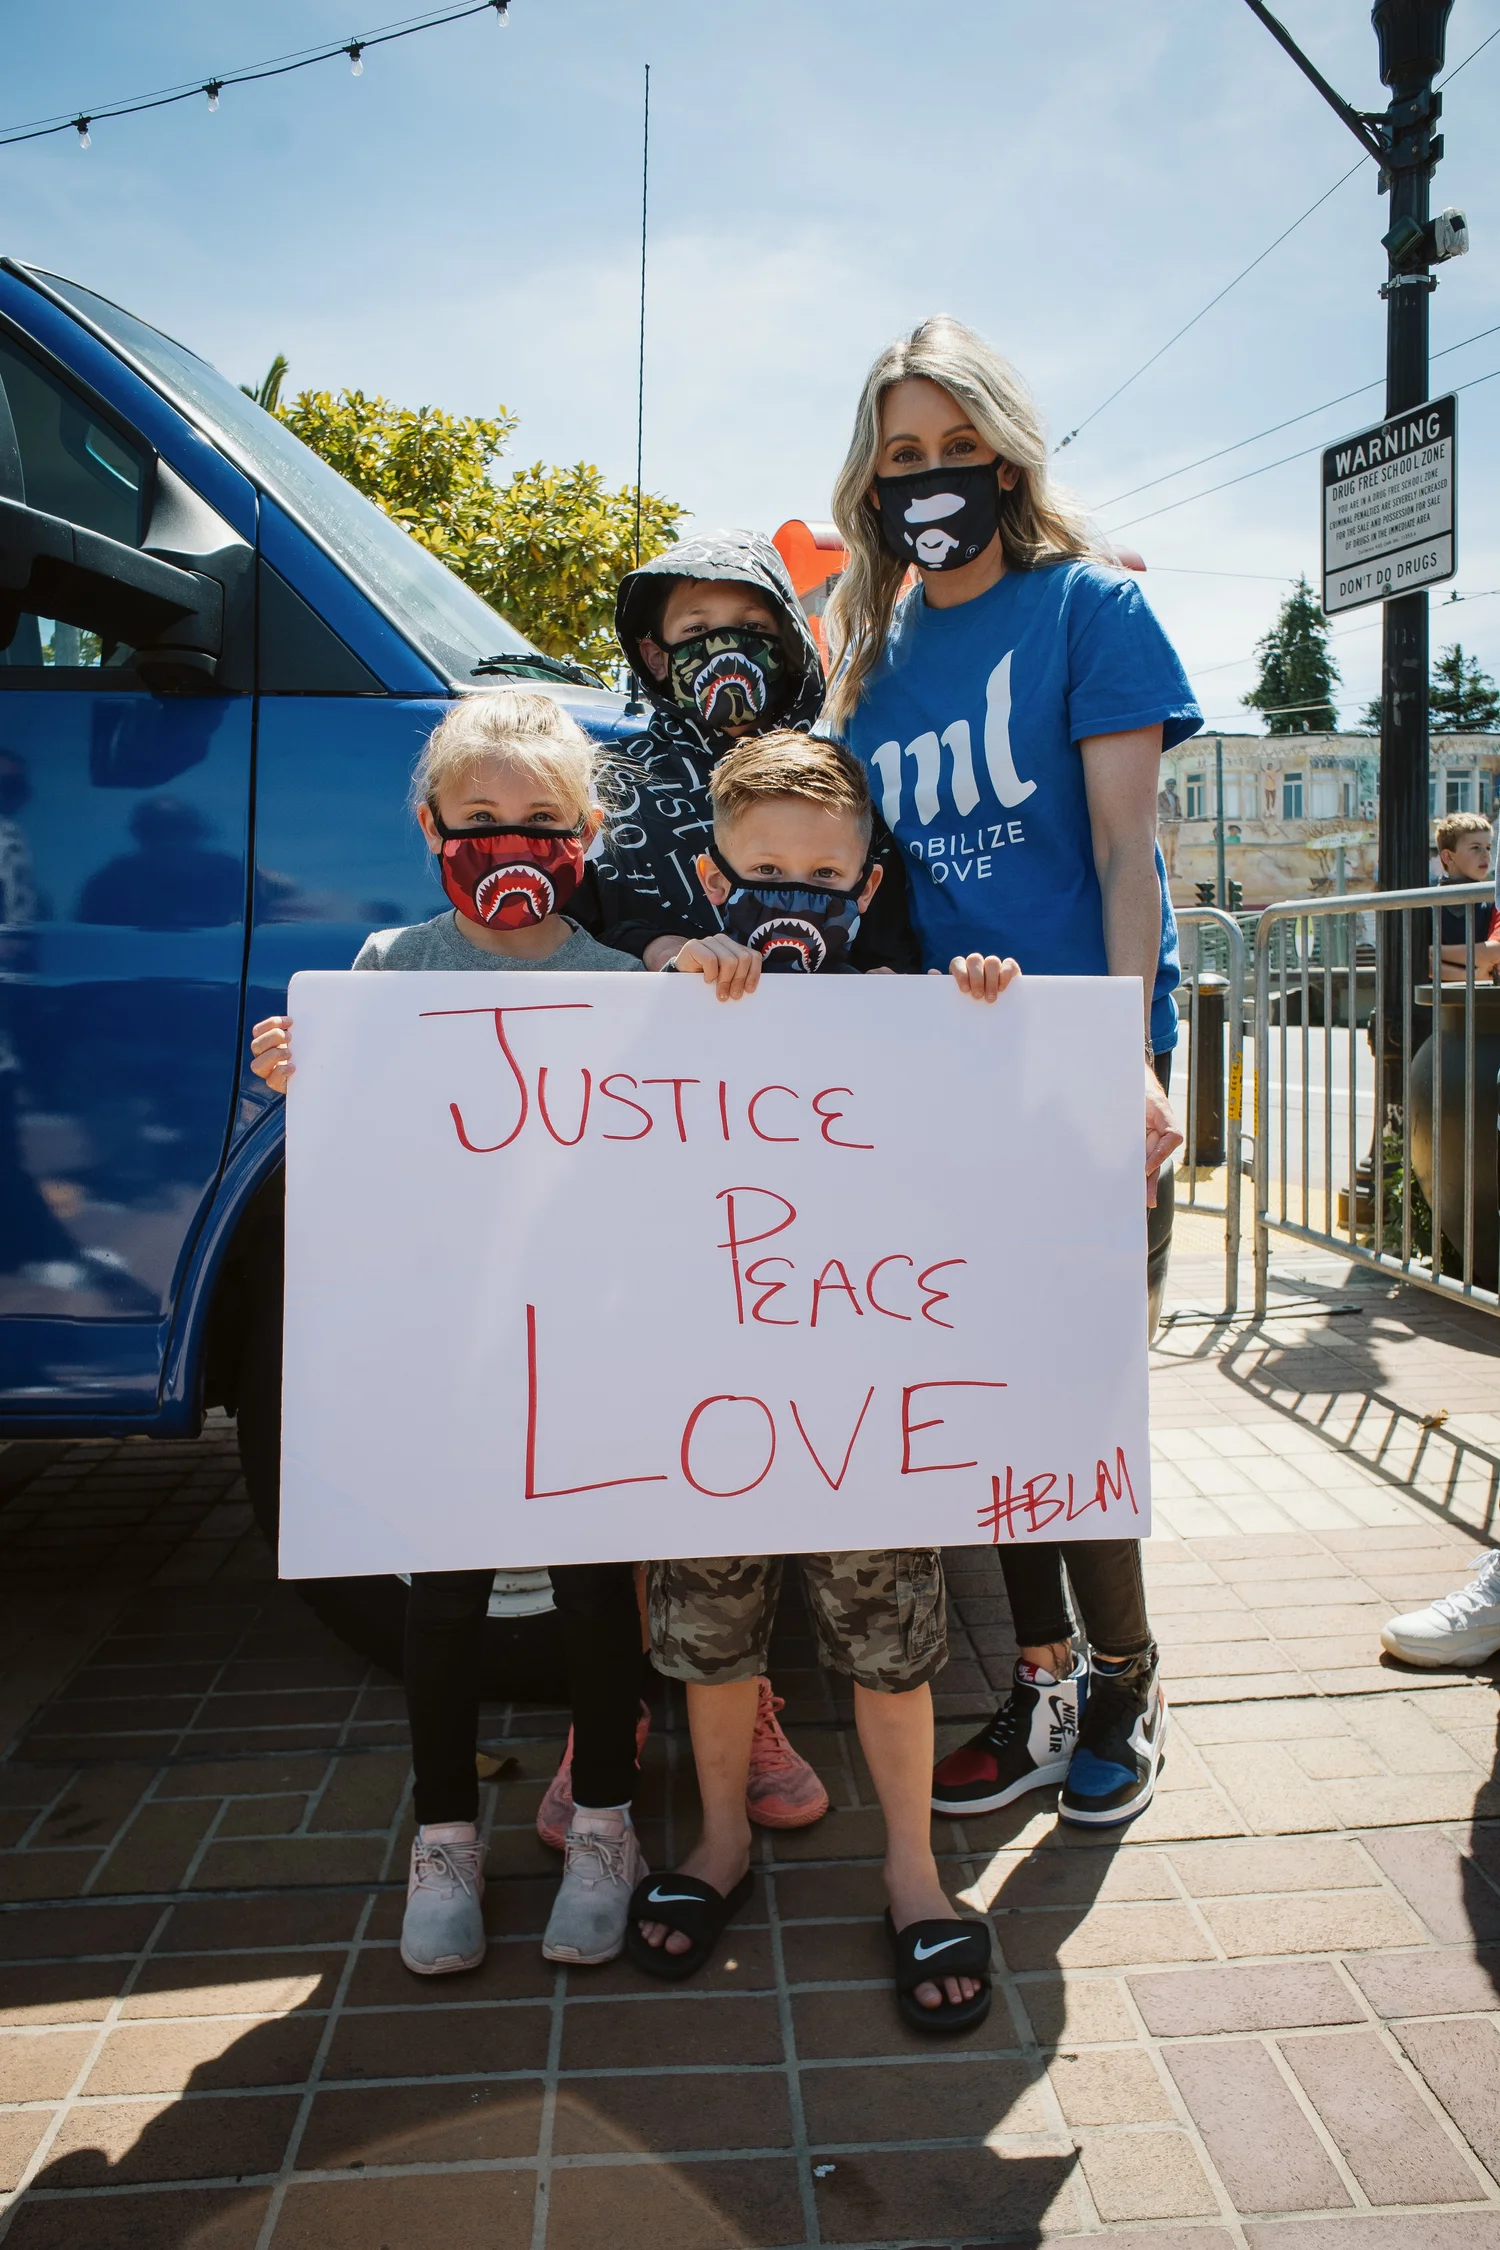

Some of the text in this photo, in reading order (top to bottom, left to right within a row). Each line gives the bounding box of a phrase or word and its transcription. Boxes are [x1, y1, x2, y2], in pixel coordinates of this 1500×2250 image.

[1335, 412, 1440, 477] WARNING
[1332, 443, 1445, 501] DRUG FREE SCHOOL ZONE
[1338, 504, 1348, 514] YOU
[1350, 499, 1359, 509] ARE
[1361, 497, 1366, 505] IN
[1372, 489, 1386, 501] DRUG
[1388, 483, 1400, 495] FREE
[1401, 476, 1423, 490] SCHOOL
[1425, 468, 1438, 481] ZONE
[1329, 478, 1448, 530] CRIMINAL PENALTIES ARE SEVERELY INCREASED
[1336, 494, 1441, 541] FOR THE SALE AND POSSESSION FOR SALE
[1345, 541, 1351, 550] OF
[1353, 534, 1370, 548] DRUGS
[1371, 532, 1377, 541] IN
[1378, 528, 1387, 538] THE
[1388, 518, 1415, 535] IMMEDIATE
[1416, 513, 1430, 525] AREA
[1340, 573, 1372, 596] DON'T
[1376, 567, 1391, 584] DO
[1397, 552, 1437, 578] DRUGS
[908, 820, 1026, 861] OBILIZE
[931, 855, 993, 885] OVE
[419, 1003, 875, 1153] JUSTICE
[716, 1186, 968, 1329] PEACE
[525, 1303, 1009, 1500] LOVE
[977, 1446, 1140, 1544] #BLM
[1049, 1724, 1063, 1753] AIR
[1062, 1702, 1077, 1737] NIKE
